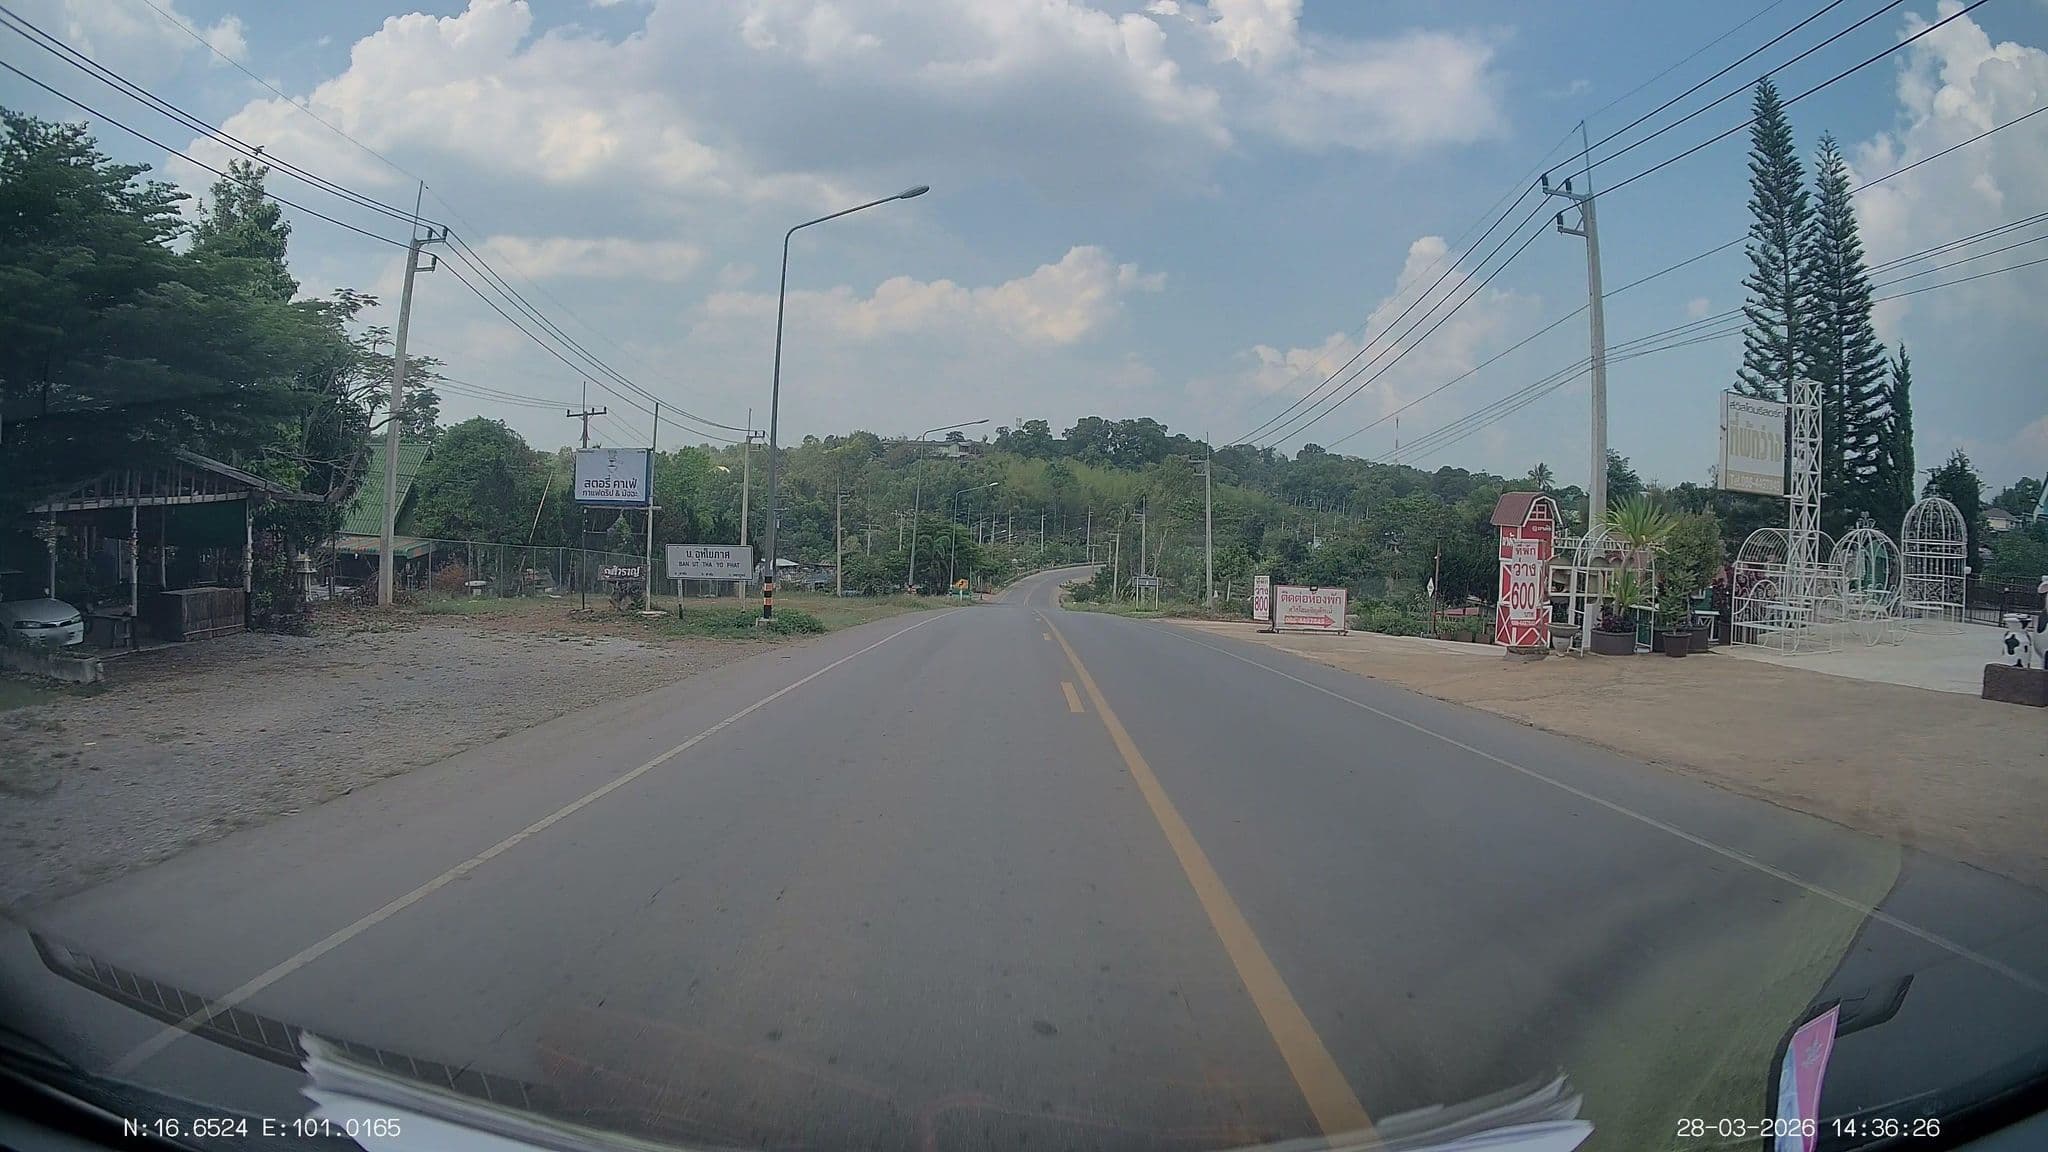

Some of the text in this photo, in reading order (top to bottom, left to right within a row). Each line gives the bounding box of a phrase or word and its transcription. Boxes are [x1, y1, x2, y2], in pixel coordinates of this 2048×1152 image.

[584, 474, 638, 489] สตอรี่ คาเฟ่
[1513, 558, 1536, 577] ว่าง
[1255, 596, 1269, 612] 800
[1511, 582, 1536, 610] 600
